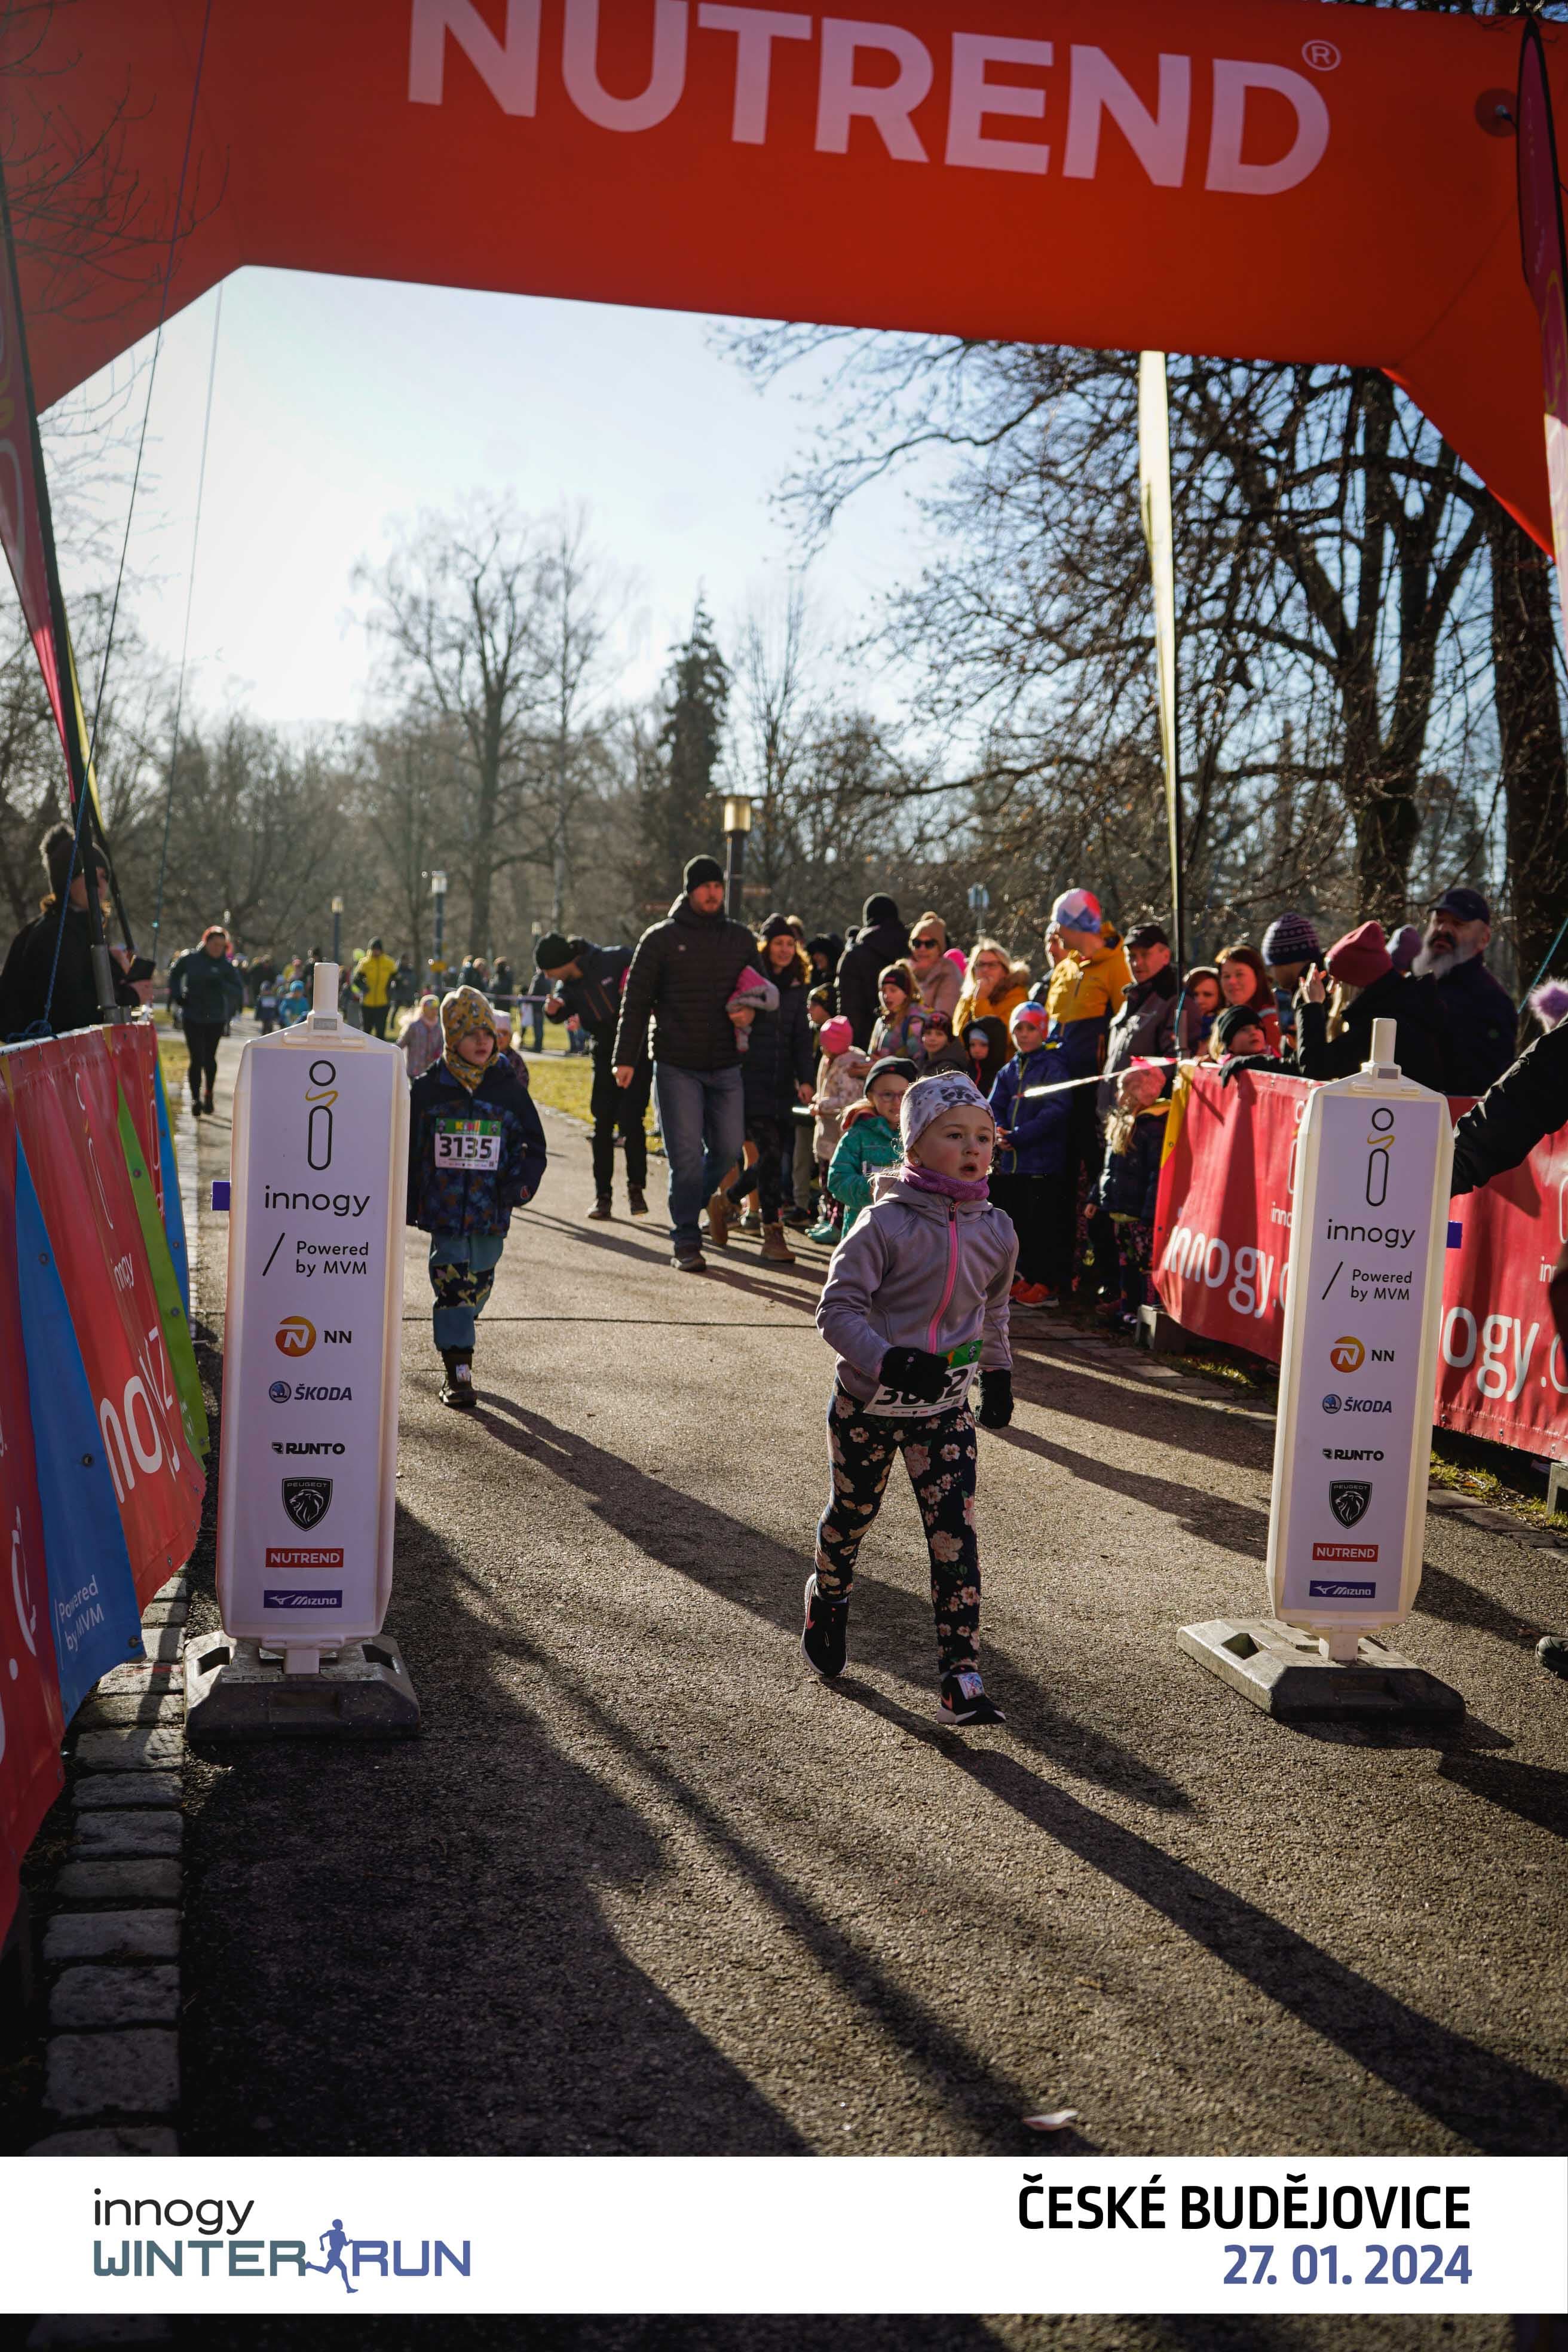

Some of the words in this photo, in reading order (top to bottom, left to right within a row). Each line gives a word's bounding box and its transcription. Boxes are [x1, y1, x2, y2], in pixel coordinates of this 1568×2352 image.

[406, 0, 1331, 195] NUTREND
[439, 1135, 492, 1159] 3135
[264, 1185, 370, 1217] innogy
[1327, 1218, 1416, 1248] innogy
[296, 1241, 369, 1256] Powered
[296, 1260, 316, 1278] by
[323, 1261, 367, 1275] MVM
[1352, 1269, 1412, 1284] Powered
[1350, 1287, 1368, 1302] by
[1373, 1288, 1410, 1301] MVM
[323, 1330, 352, 1344] NN
[1371, 1349, 1395, 1362] NN
[294, 1383, 353, 1401] ŠKODA
[1343, 1396, 1392, 1413] ŠKODA
[286, 1443, 345, 1455] RUNTO
[1334, 1448, 1384, 1462] RUNTO
[270, 1552, 340, 1564] NUTREND
[1316, 1547, 1375, 1558] NUTREND
[59, 1574, 99, 1624] Powered
[65, 1631, 78, 1652] by
